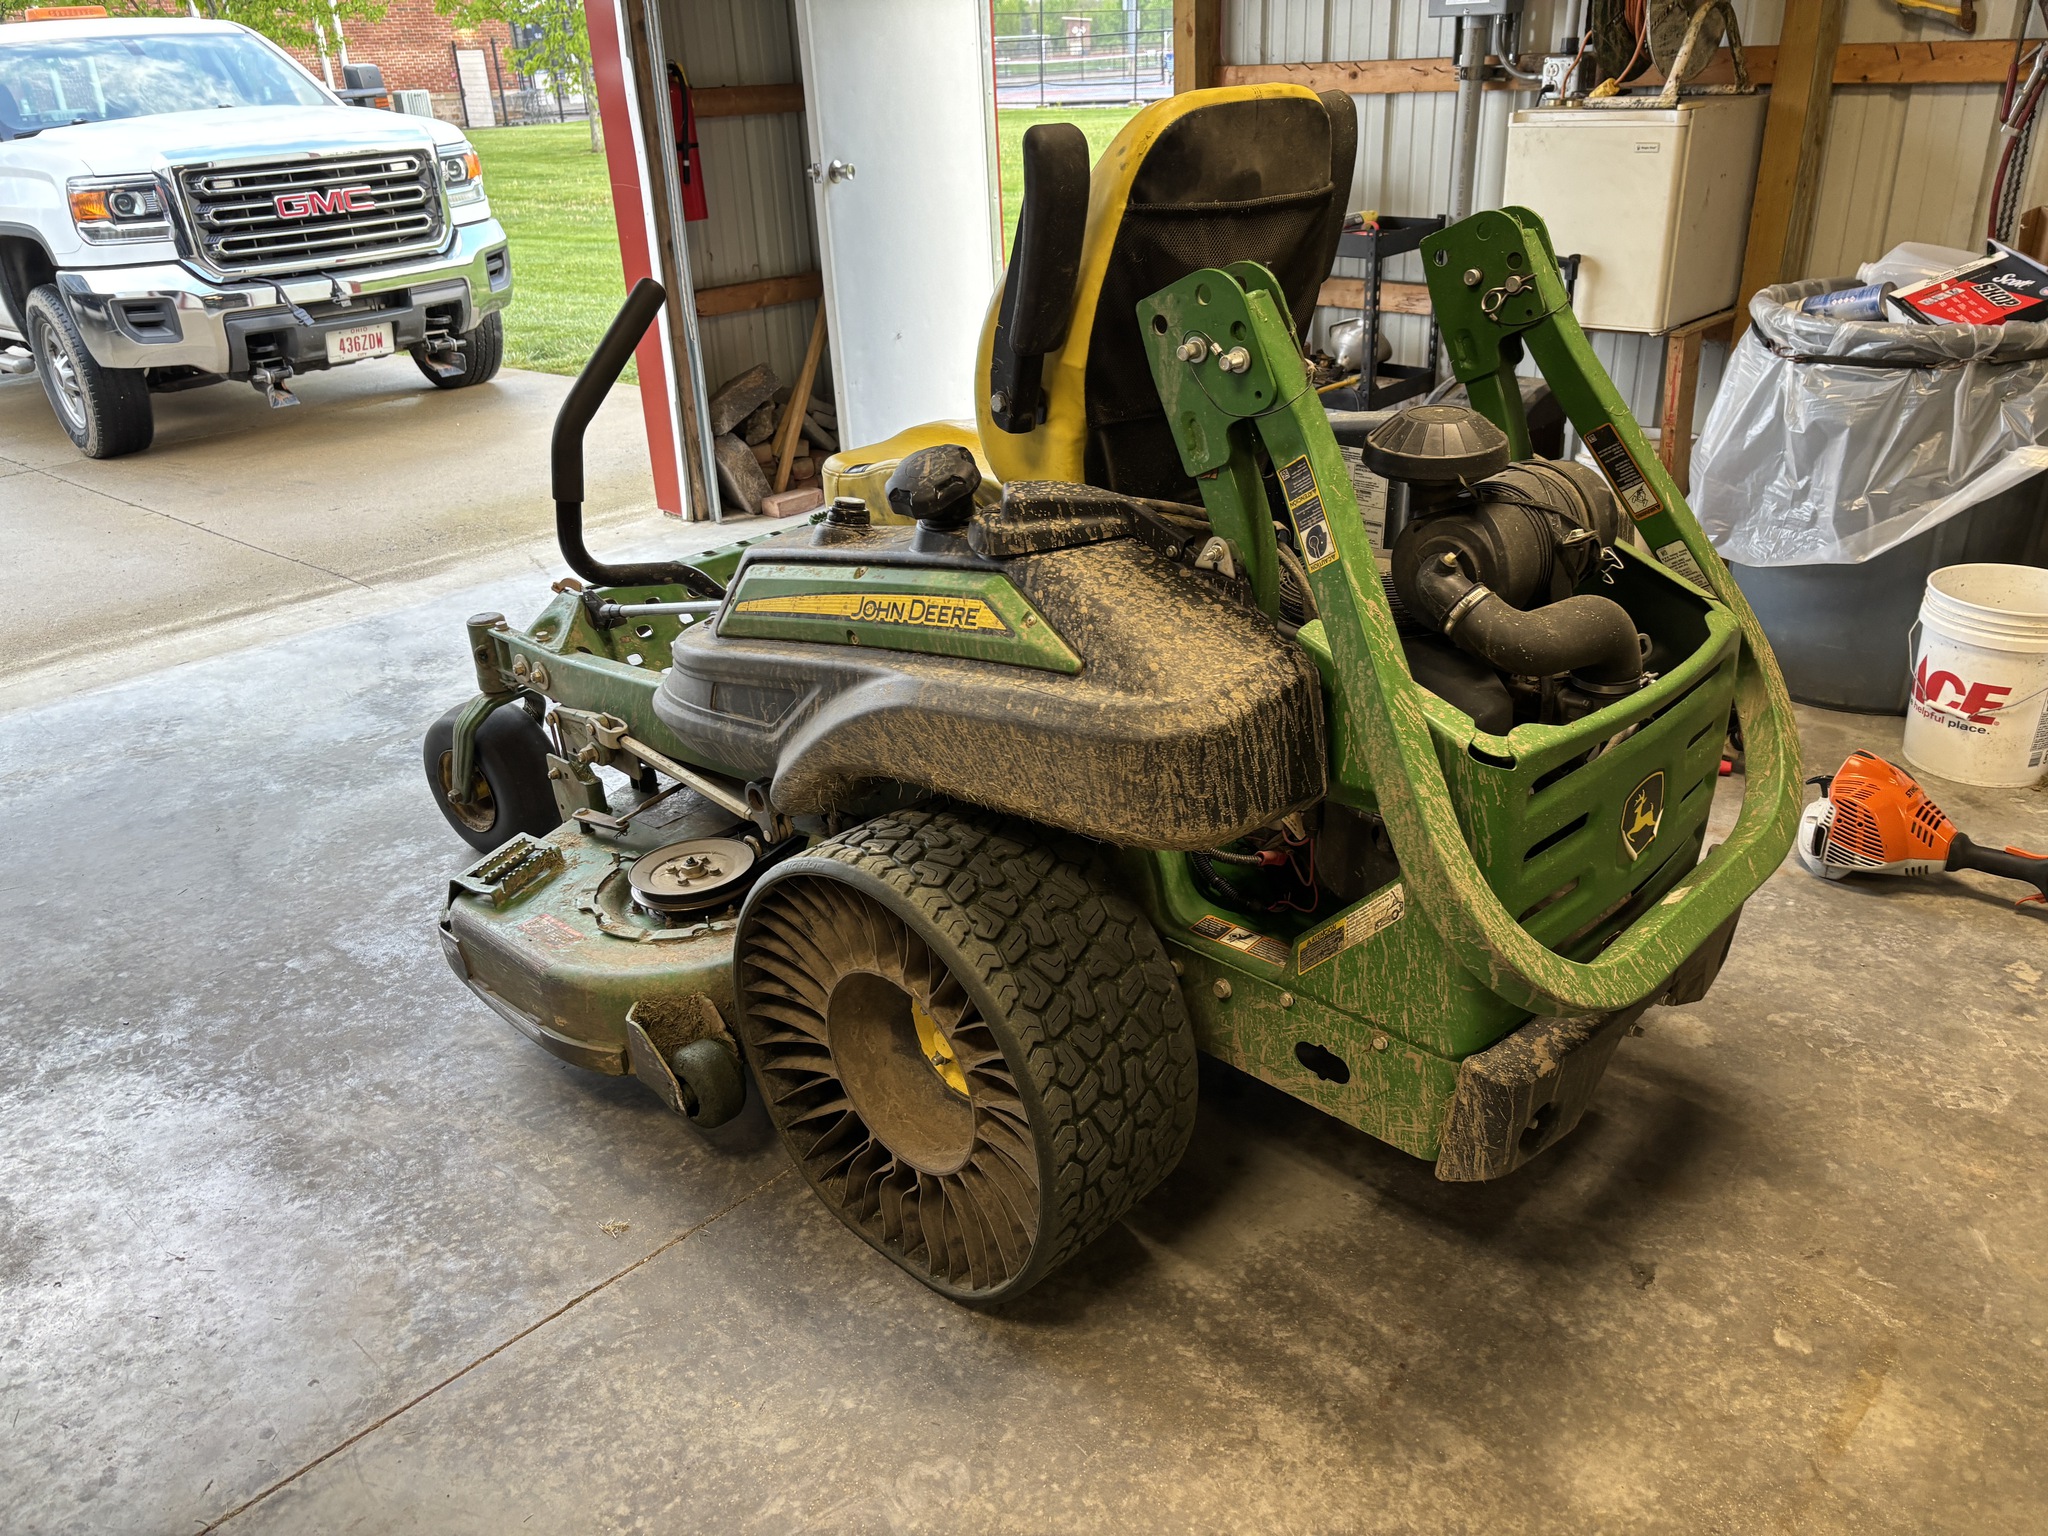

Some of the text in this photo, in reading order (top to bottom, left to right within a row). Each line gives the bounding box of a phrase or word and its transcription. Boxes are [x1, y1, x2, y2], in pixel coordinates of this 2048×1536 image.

[274, 185, 376, 220] GMC
[1992, 273, 2036, 289] Scott
[1973, 283, 2021, 307] SHOP
[339, 331, 383, 354] 436ZDW
[350, 326, 368, 334] OHIO
[851, 596, 980, 627] JOHN DEERE
[1911, 653, 2013, 726] ACE
[1913, 702, 1945, 724] helpful
[1947, 719, 1990, 735] place.
